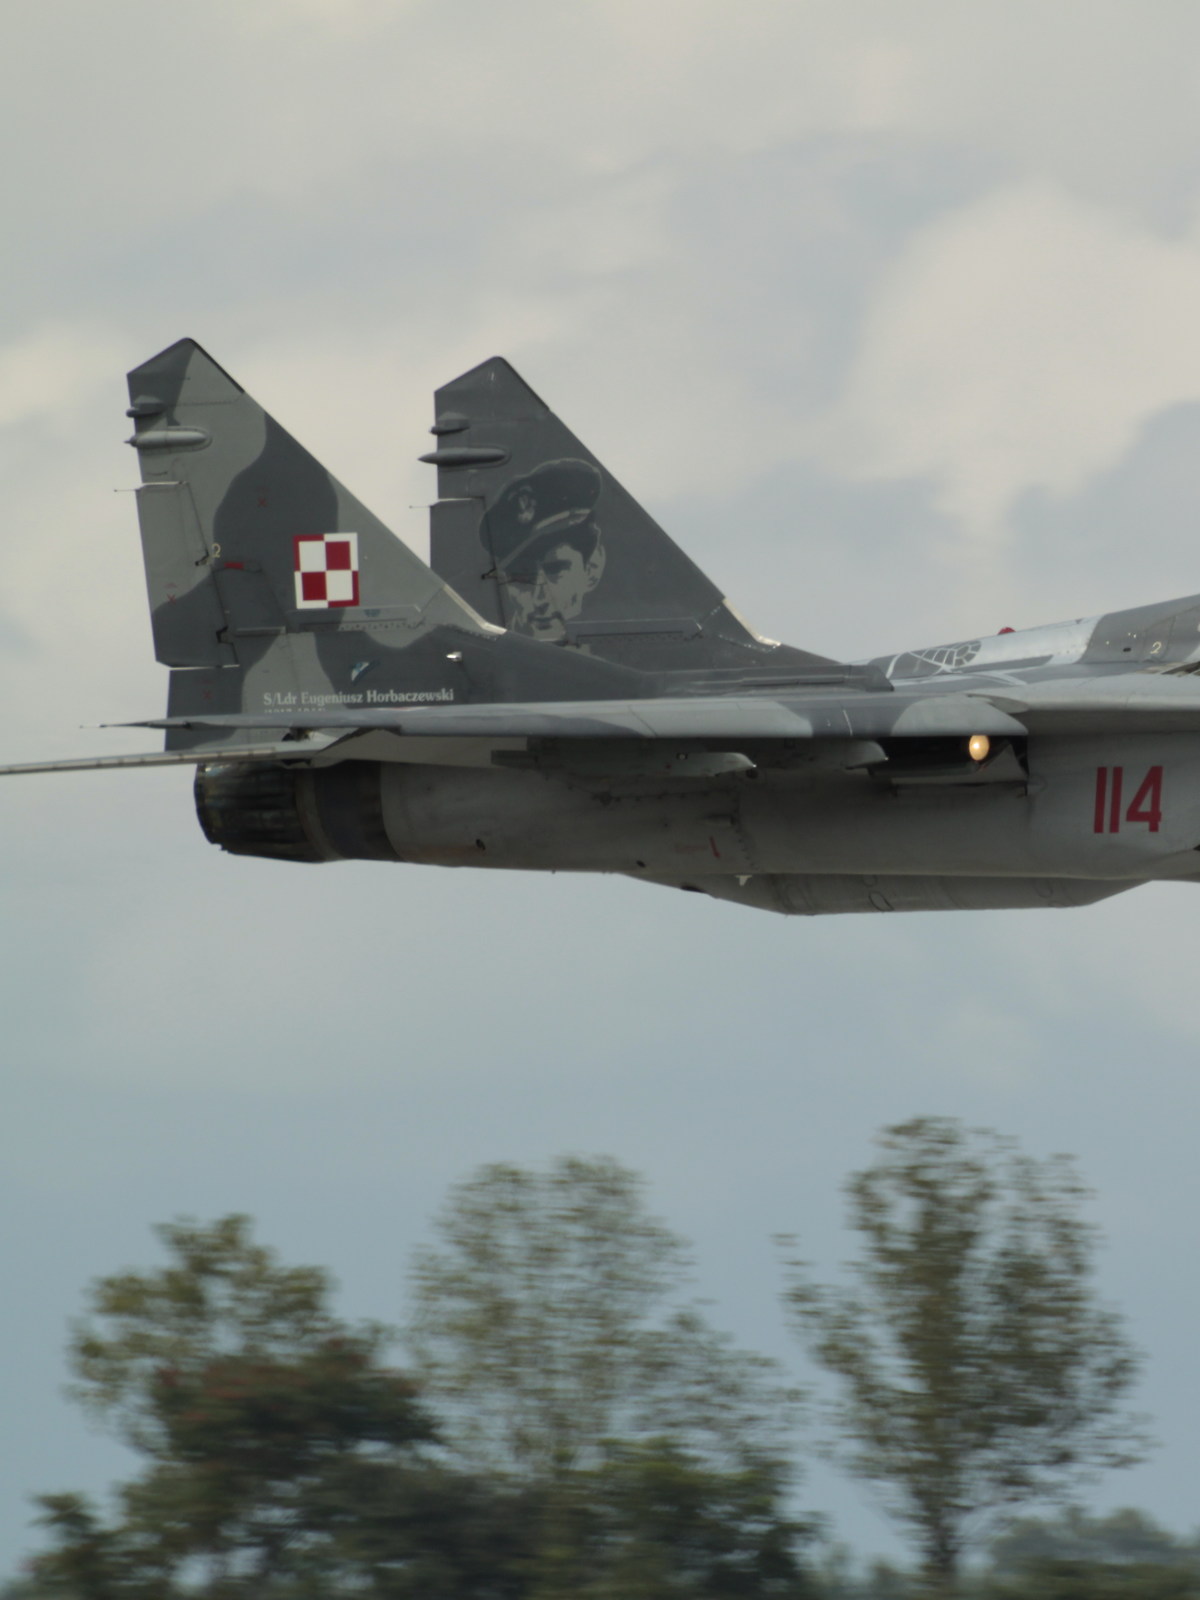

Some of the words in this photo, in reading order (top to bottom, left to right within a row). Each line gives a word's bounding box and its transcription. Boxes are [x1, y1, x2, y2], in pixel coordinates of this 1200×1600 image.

[1149, 641, 1162, 655] 2
[263, 692, 298, 707] S/Ldr
[301, 691, 363, 706] Eugeniusz
[366, 688, 454, 703] Horbaczewski
[1093, 766, 1163, 833] 114
